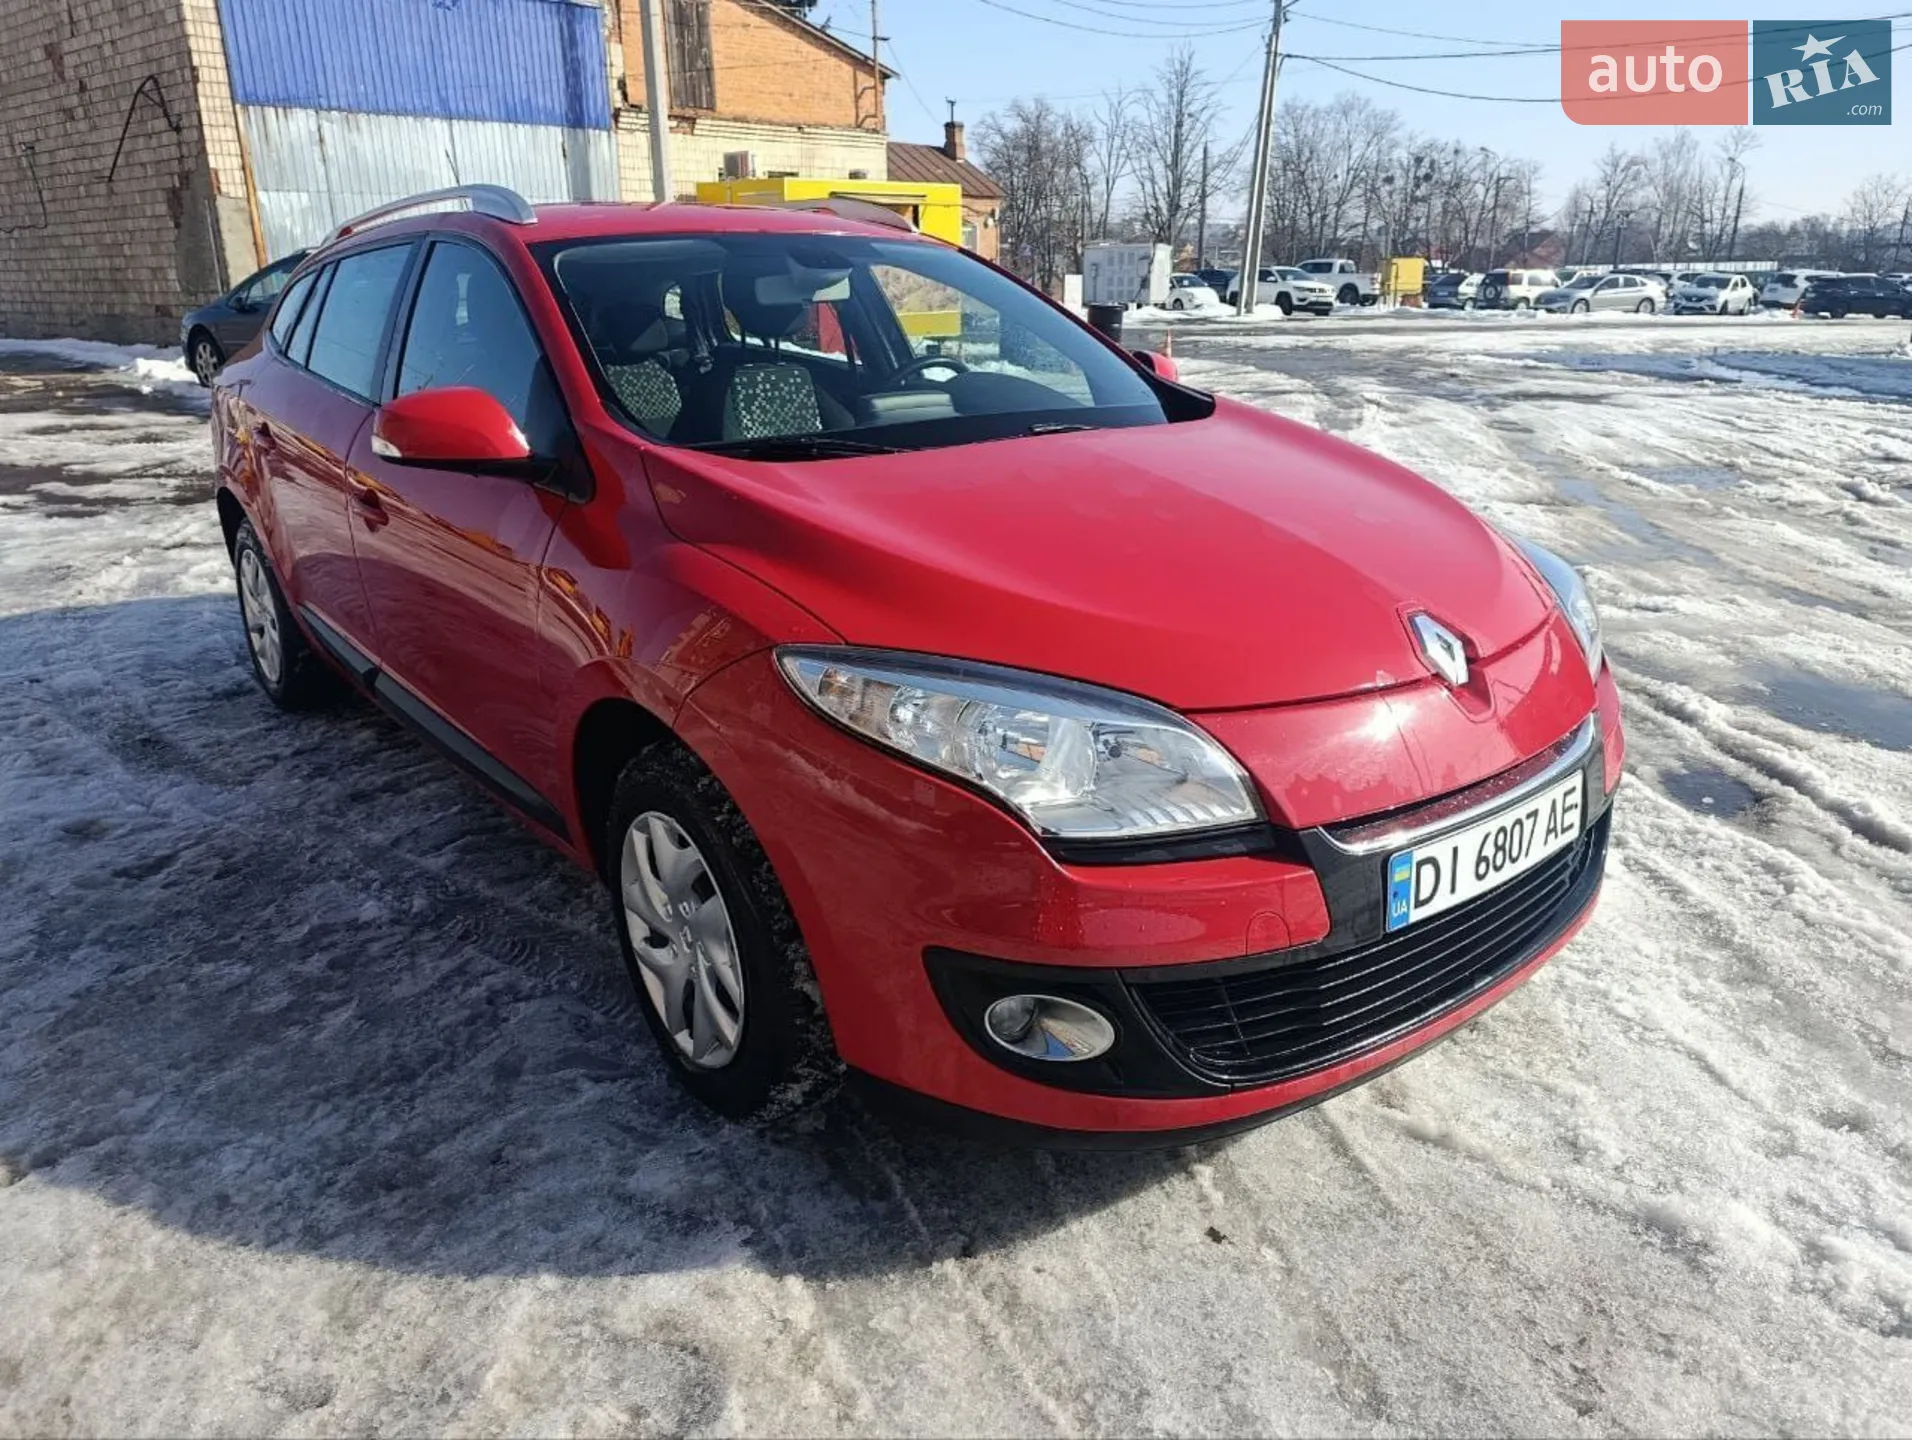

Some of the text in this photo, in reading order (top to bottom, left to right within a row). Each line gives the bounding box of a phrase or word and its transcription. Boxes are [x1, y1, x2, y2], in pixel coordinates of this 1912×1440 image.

[1413, 786, 1577, 910] DI 6807 AE
[1392, 900, 1408, 917] UA
